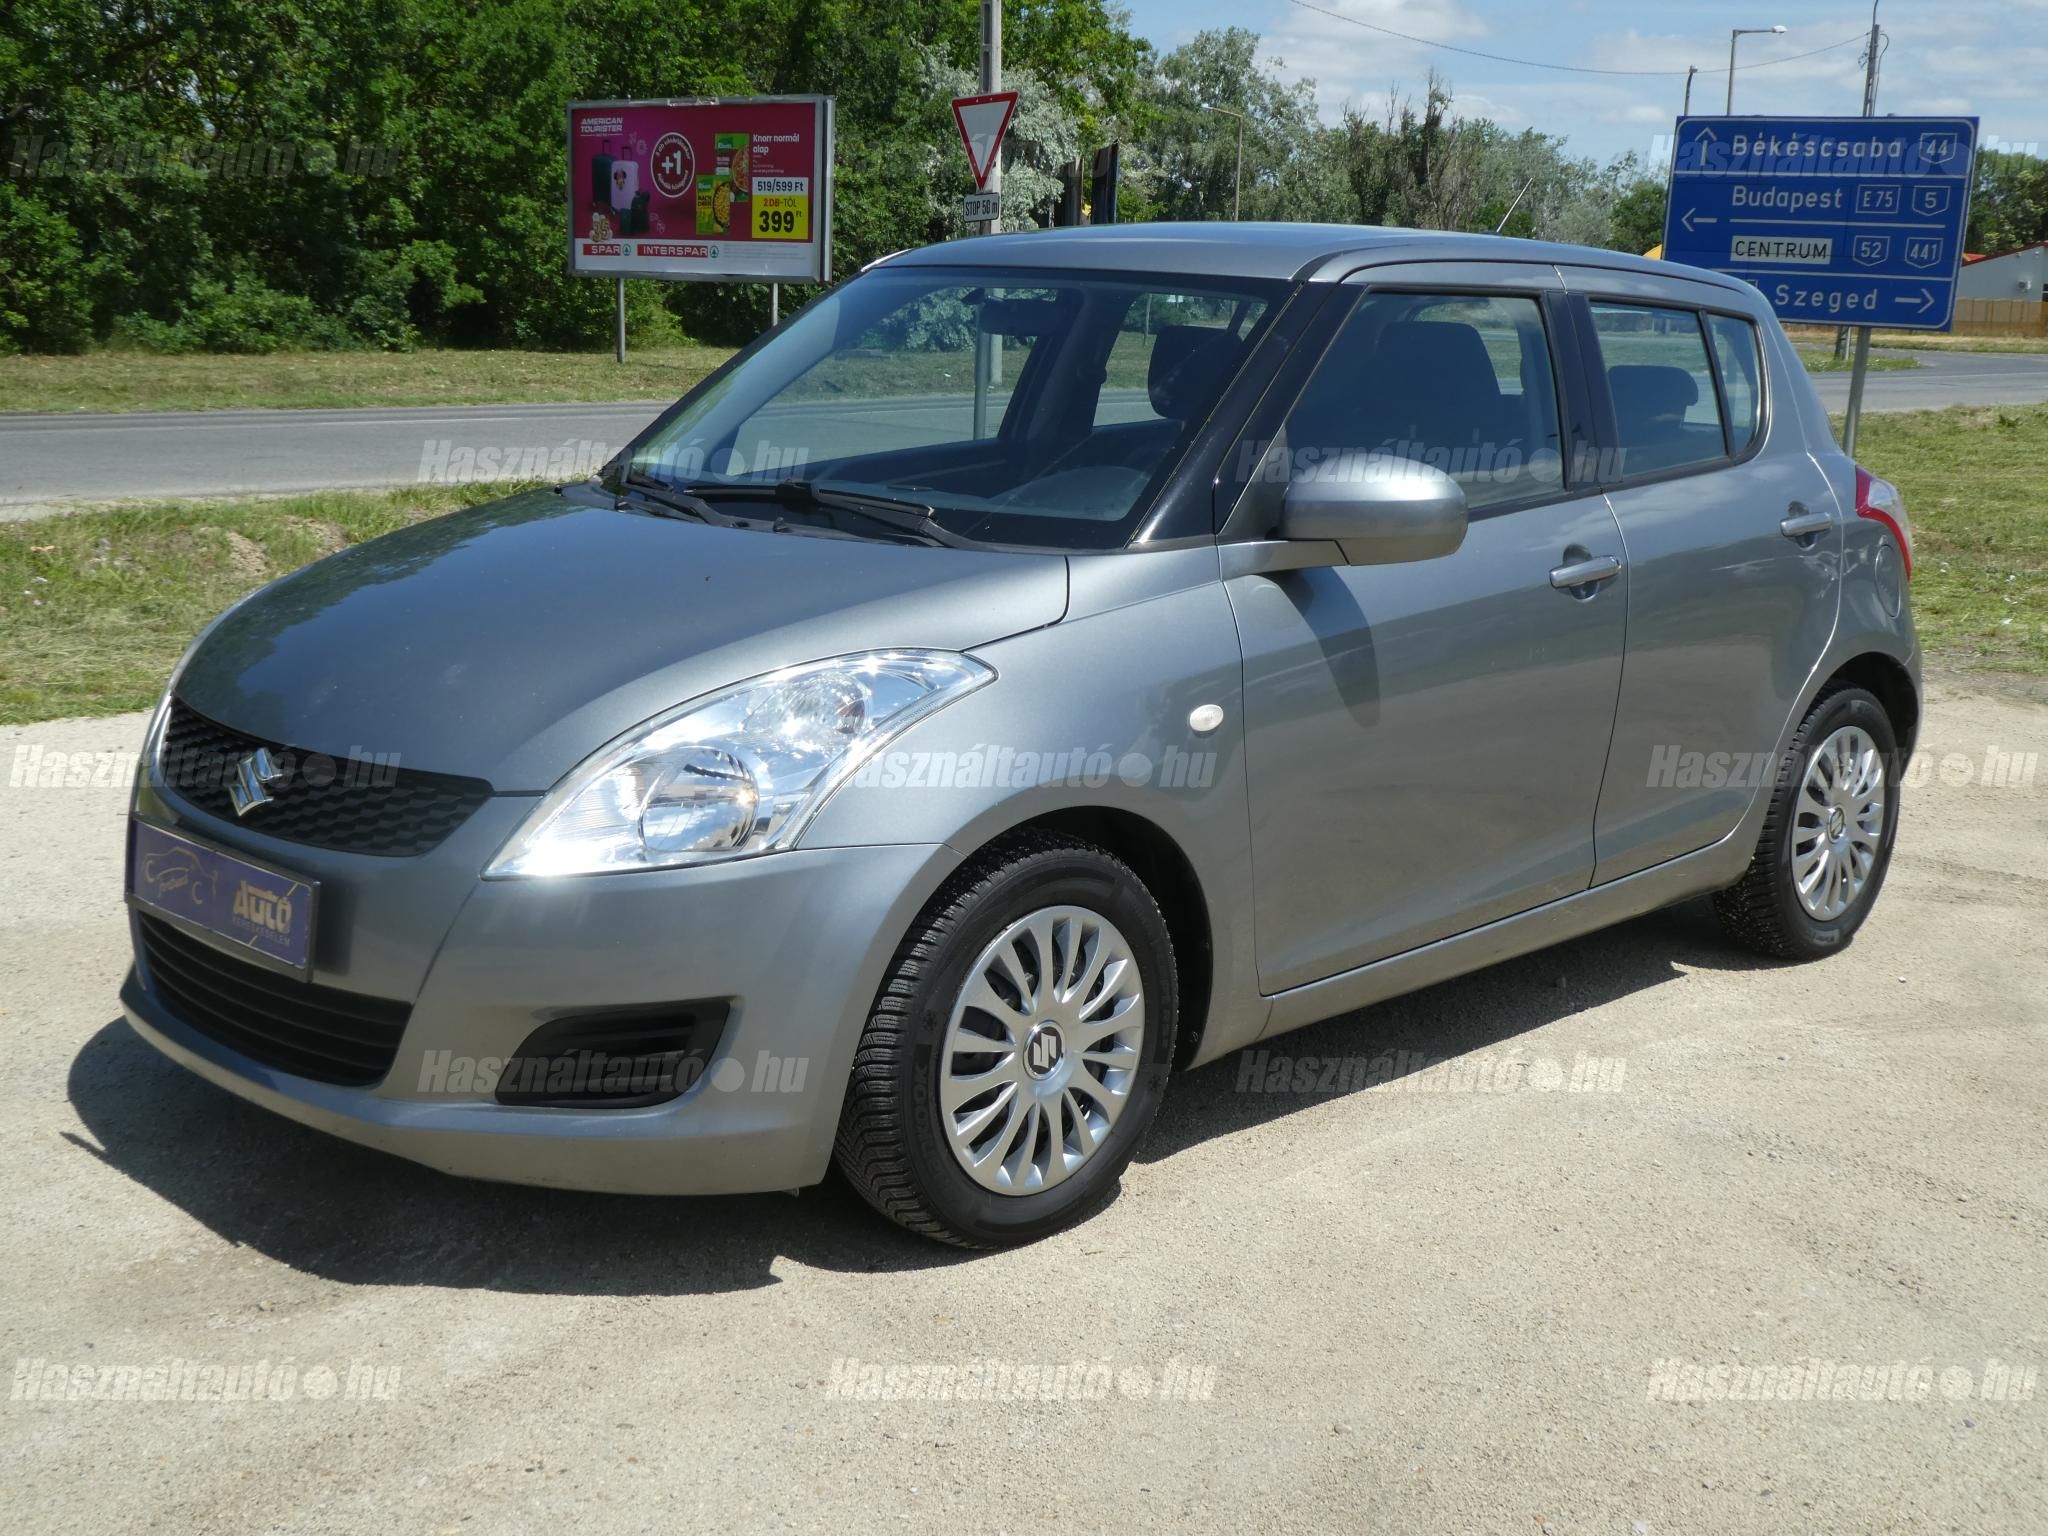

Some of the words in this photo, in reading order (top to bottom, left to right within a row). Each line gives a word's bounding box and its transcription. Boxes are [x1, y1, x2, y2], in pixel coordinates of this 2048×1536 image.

[581, 117, 624, 125] AMERICAN
[580, 125, 623, 133] TOURISTER
[753, 134, 772, 142] Knorr
[773, 133, 800, 142] normál
[753, 145, 769, 156] alap
[1732, 131, 1901, 159] Békéscsaba
[1926, 140, 1948, 157] 44
[757, 180, 792, 193] 519/599
[794, 181, 804, 192] Ft
[1732, 185, 1843, 213] Budapest
[1924, 192, 1937, 208] 5
[965, 201, 981, 216] STOP
[982, 201, 991, 216] 50
[759, 210, 795, 233] 399
[591, 245, 620, 255] SPAR
[643, 245, 707, 256] INTERSPAR
[1735, 240, 1827, 259] CENTRUM
[1861, 242, 1882, 259] 52
[1910, 244, 1937, 261] 441
[1775, 284, 1878, 313] Szeged
